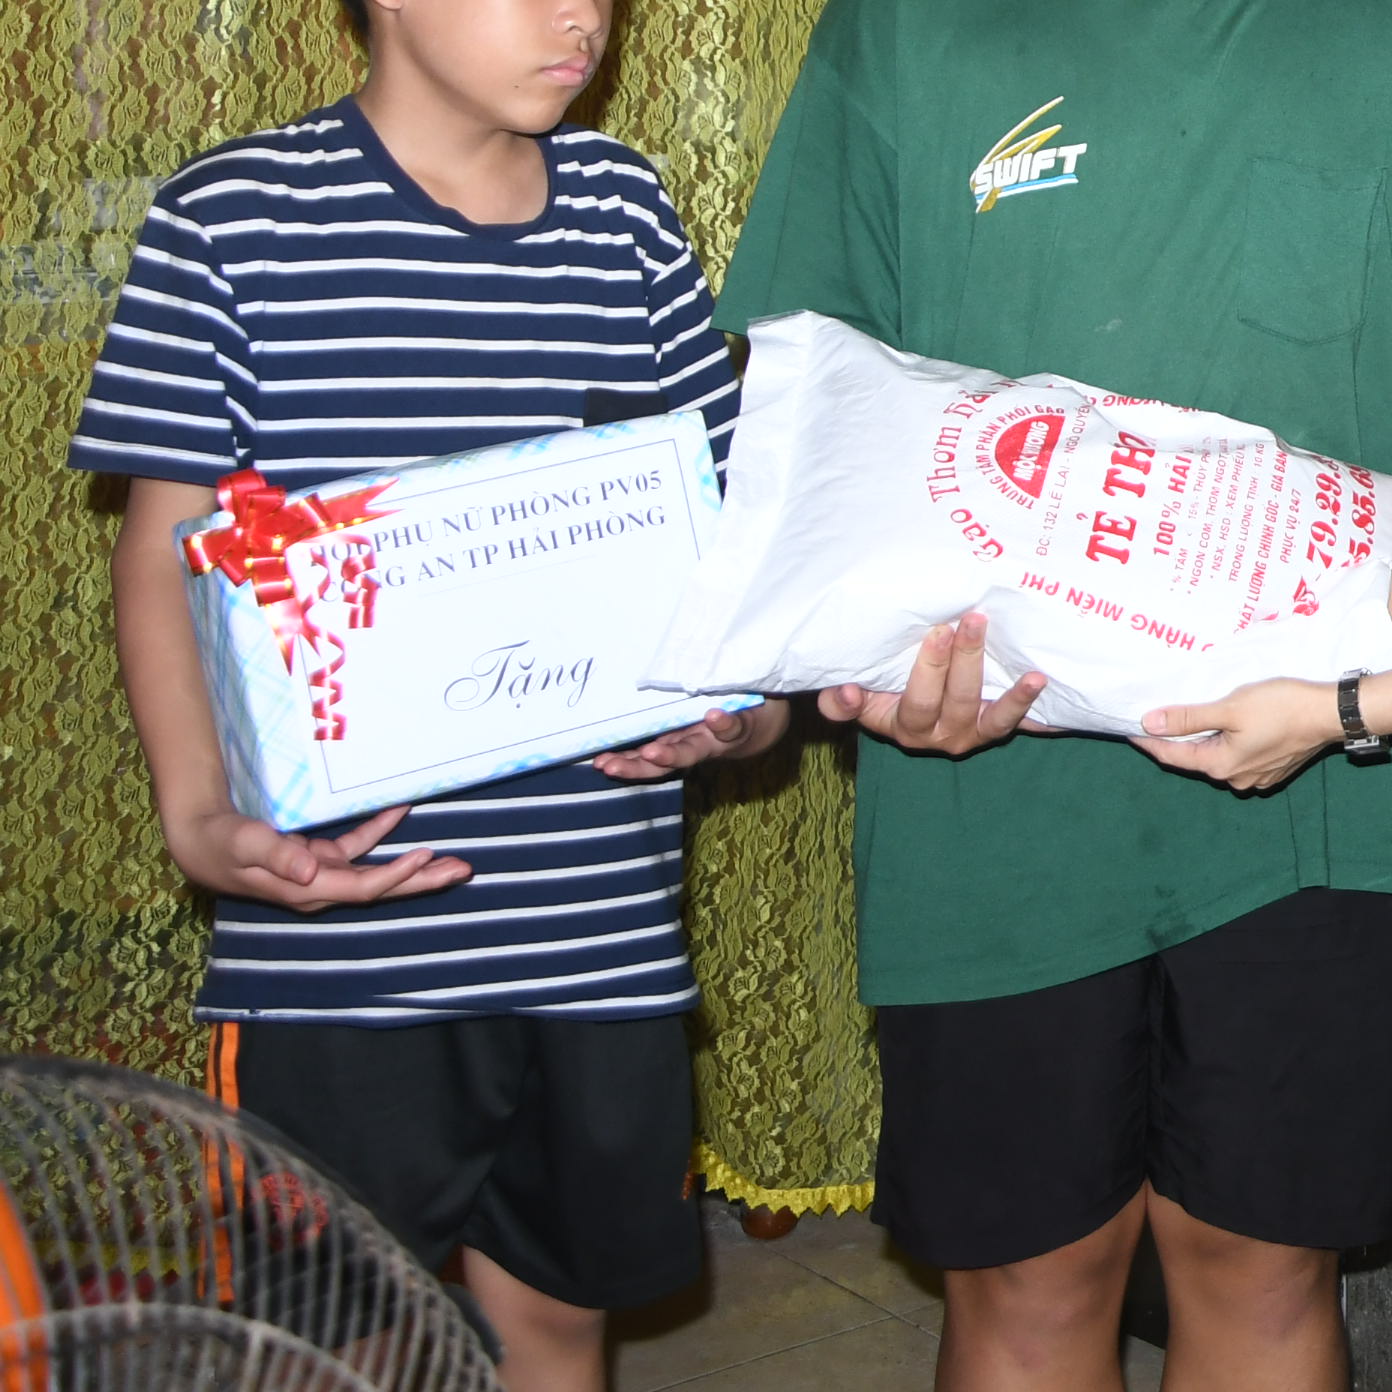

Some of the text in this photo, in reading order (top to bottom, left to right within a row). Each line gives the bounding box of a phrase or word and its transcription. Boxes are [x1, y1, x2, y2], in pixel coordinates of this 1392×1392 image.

[973, 142, 1088, 196] SWIFT
[926, 426, 963, 504] Thơm
[372, 519, 434, 554] PHỤ
[441, 505, 484, 536] NỮ
[490, 485, 592, 527] PHÒNG
[599, 469, 663, 502] PV05
[989, 476, 1035, 510] TRUNG
[1225, 484, 1239, 510] XEM
[417, 553, 457, 583] AN
[462, 543, 499, 569] TP
[507, 526, 560, 561] HẢI
[567, 505, 666, 546] PHÒNG
[1042, 511, 1058, 531] 132
[1153, 502, 1183, 556] 100%
[1219, 517, 1232, 542] HSD
[1279, 487, 1303, 565] PHỤC VỤ 24/7
[1017, 571, 1061, 596] PHÍ
[1130, 613, 1196, 651] HÀNG
[443, 638, 599, 712] Tặng
